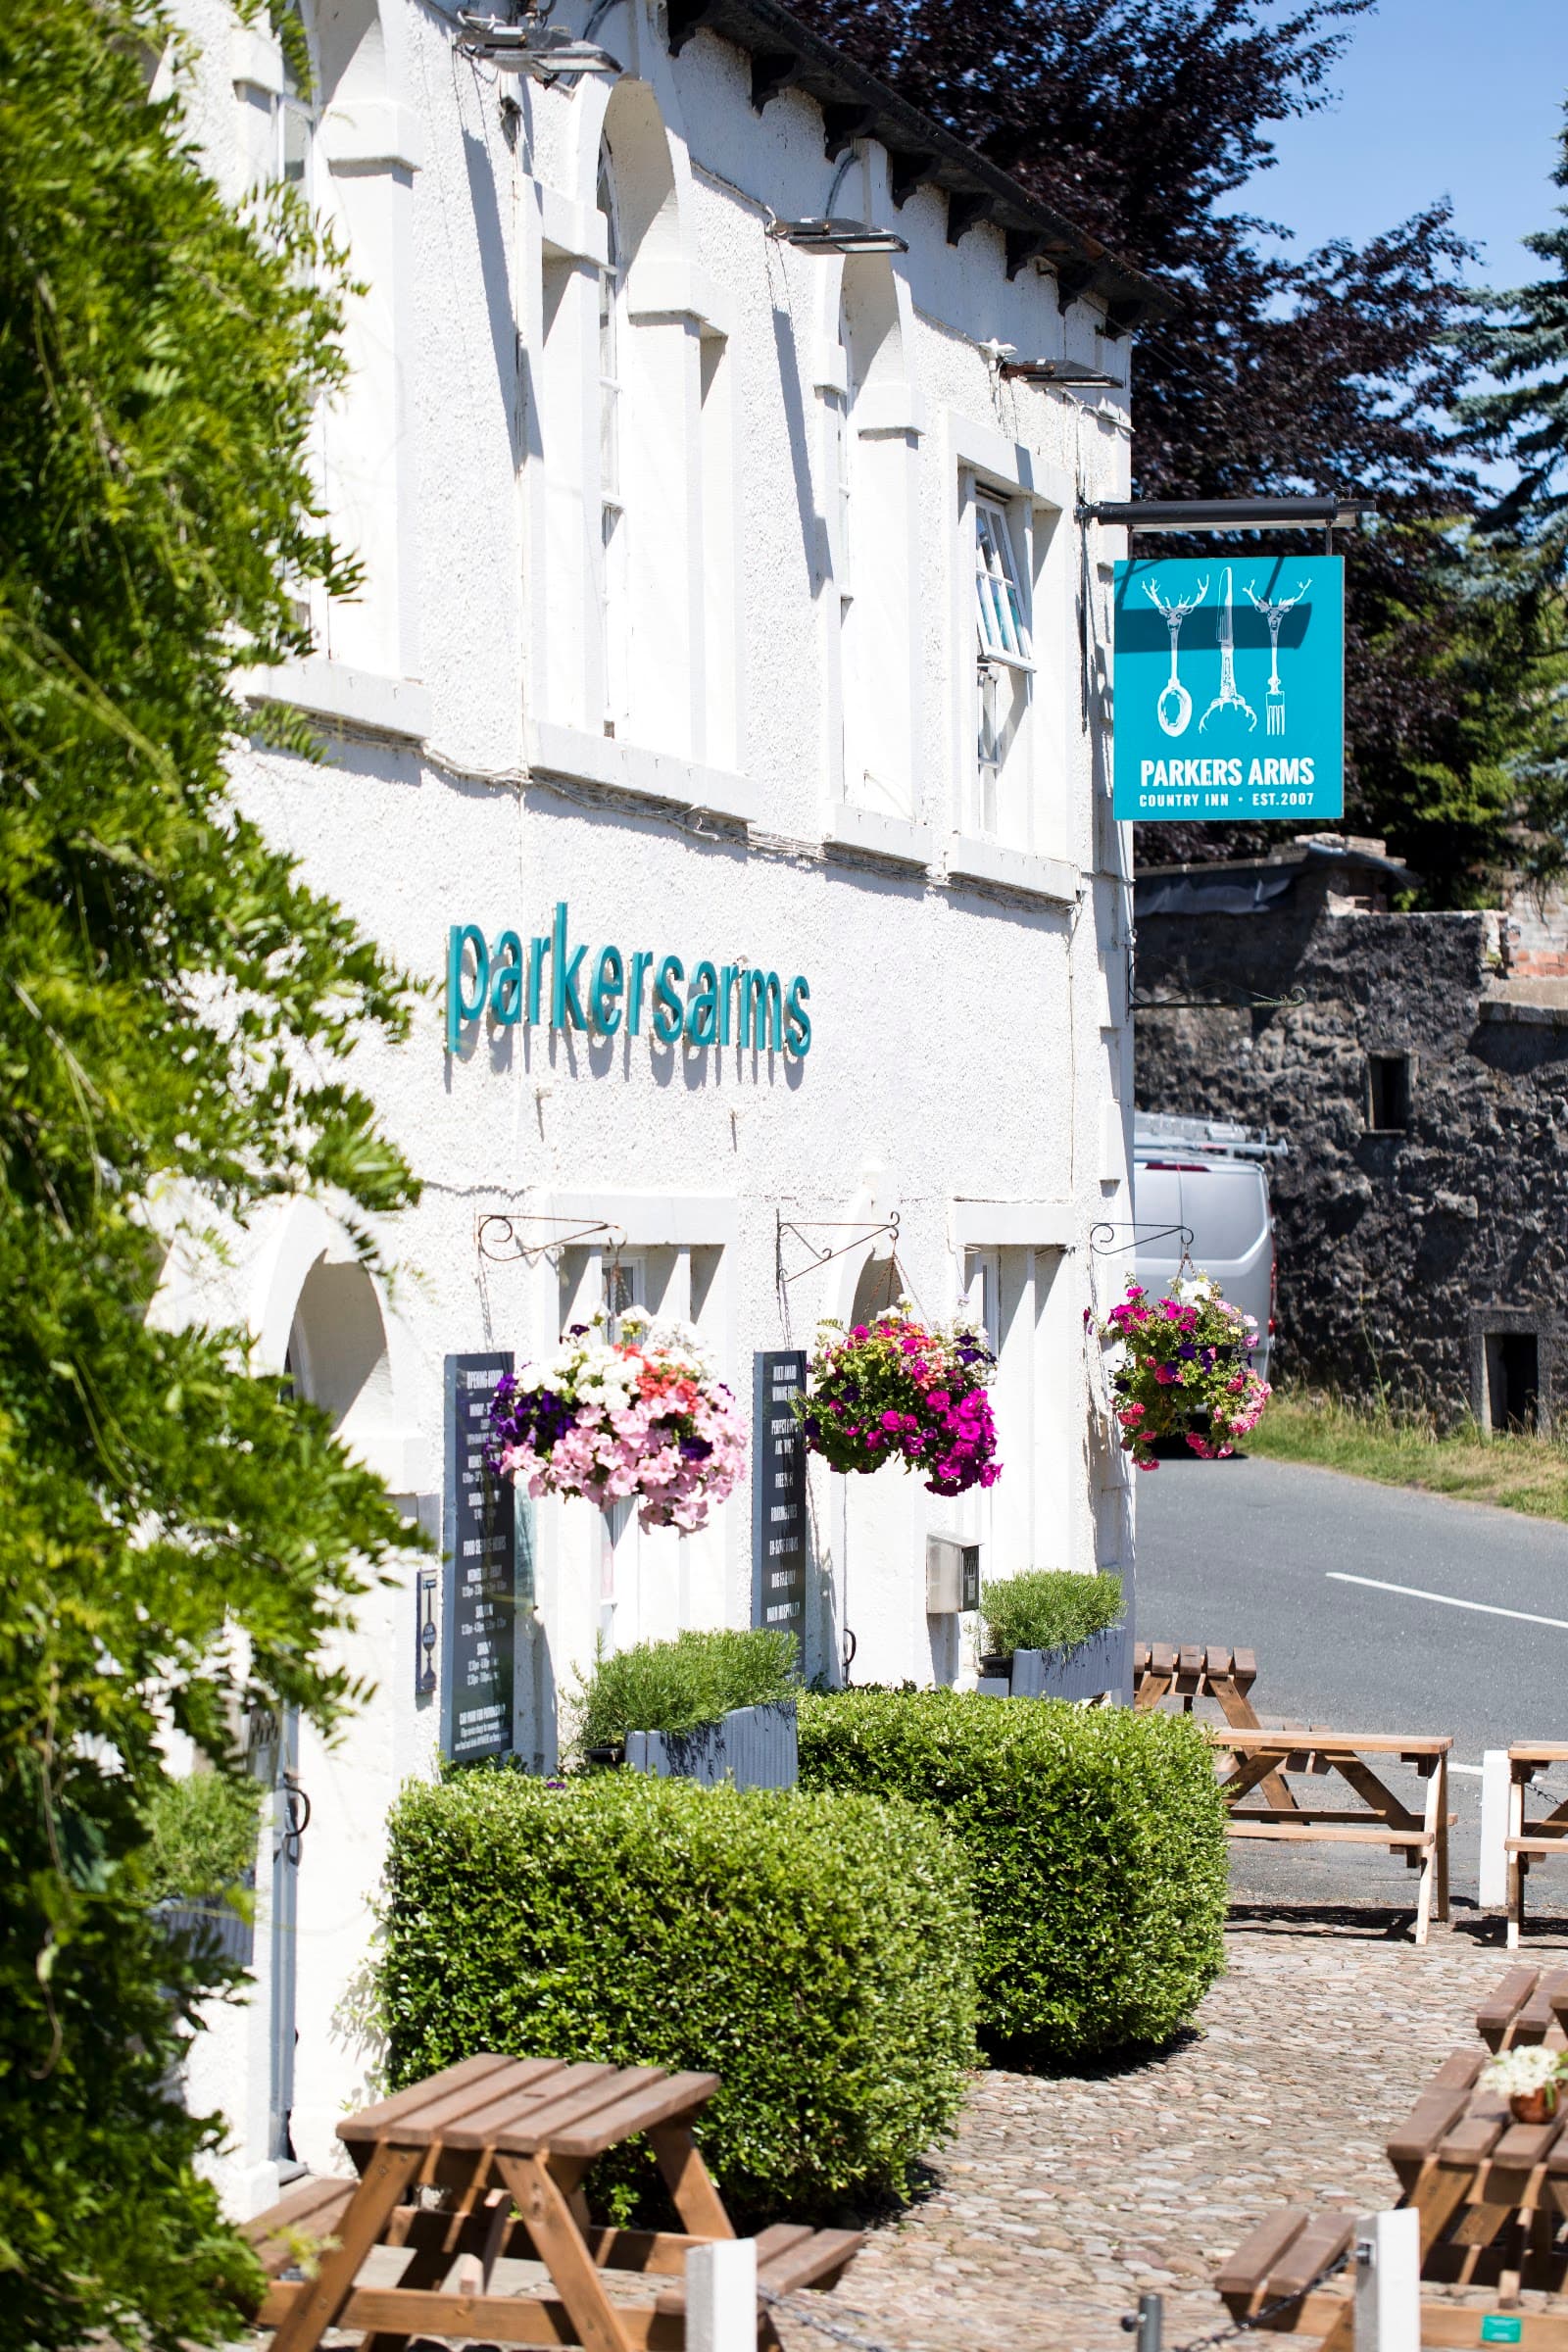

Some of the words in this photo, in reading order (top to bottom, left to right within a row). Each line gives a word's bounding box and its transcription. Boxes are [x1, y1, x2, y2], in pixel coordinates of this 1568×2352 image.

[1140, 759, 1243, 787] PARKERS
[1248, 757, 1315, 786] ARMS
[1139, 793, 1200, 808] COUNTRY
[1205, 793, 1229, 807] INN
[1252, 792, 1314, 807] EST.2007
[447, 902, 811, 1057] parkersarms
